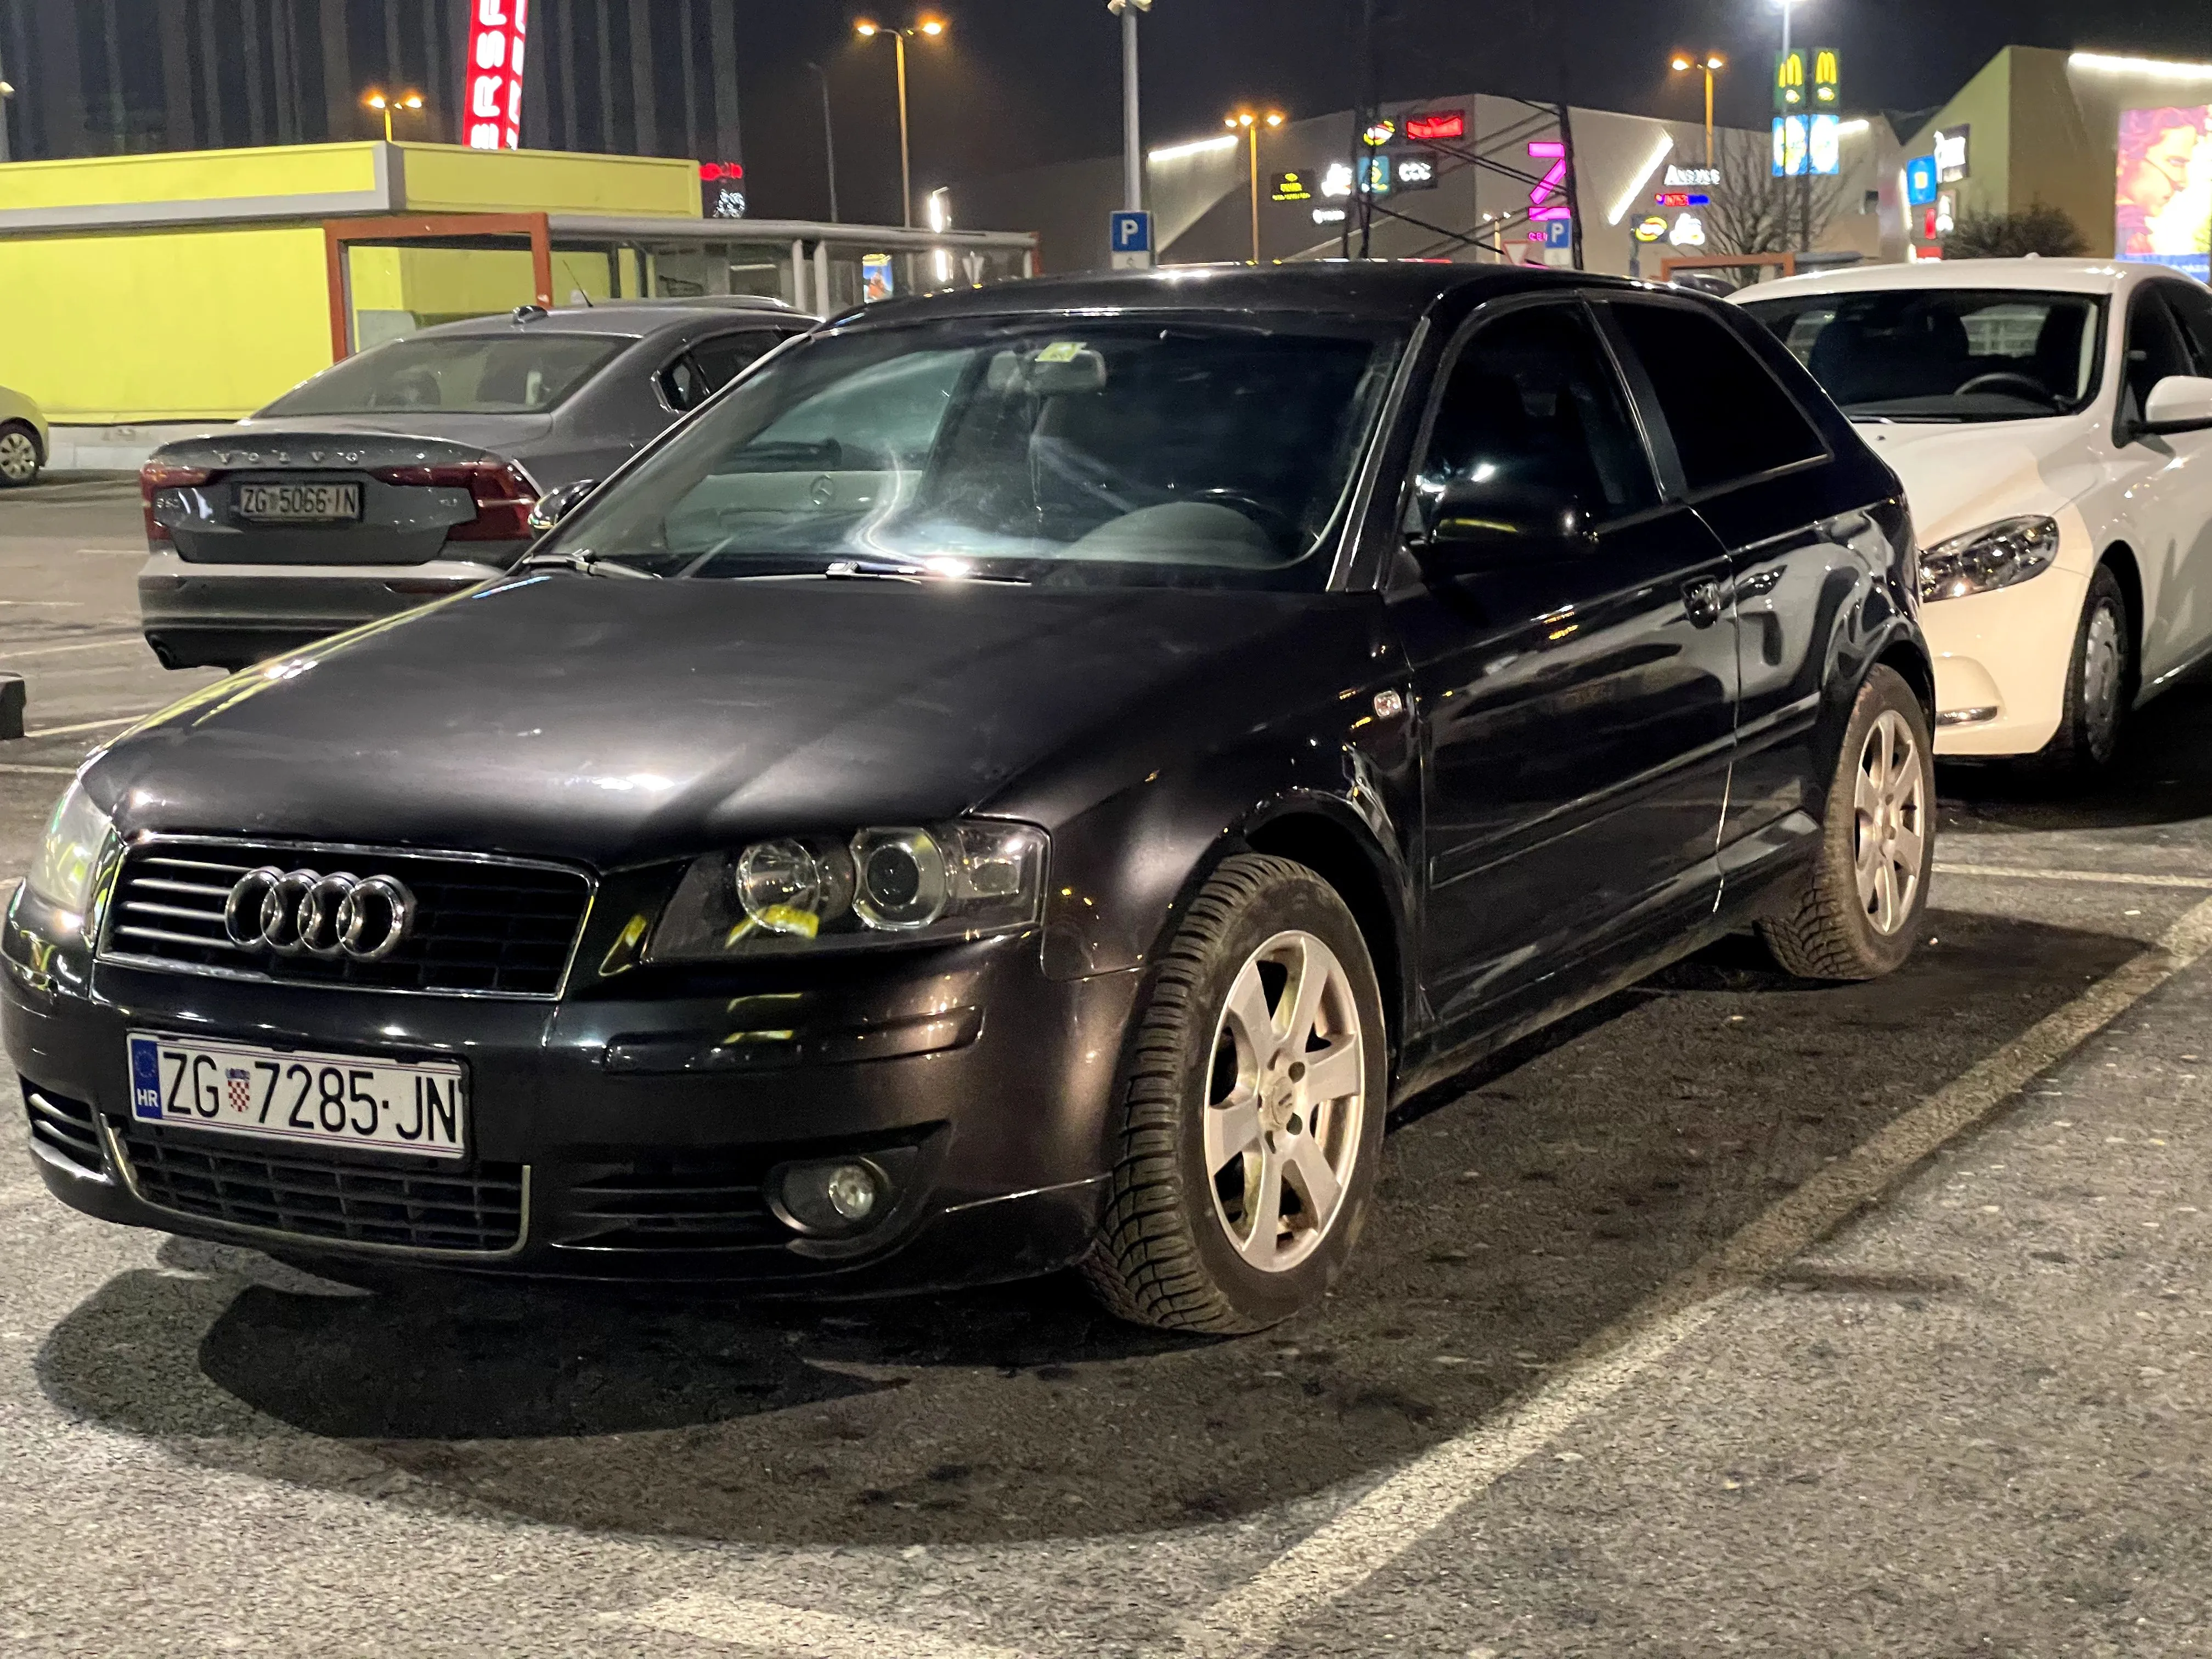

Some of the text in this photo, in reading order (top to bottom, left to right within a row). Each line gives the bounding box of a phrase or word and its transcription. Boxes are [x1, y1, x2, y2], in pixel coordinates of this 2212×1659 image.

[1121, 219, 1138, 245] P
[1551, 222, 1564, 243] P
[244, 488, 266, 512] ZG
[163, 1051, 219, 1118] ZG
[136, 1088, 158, 1107] HR
